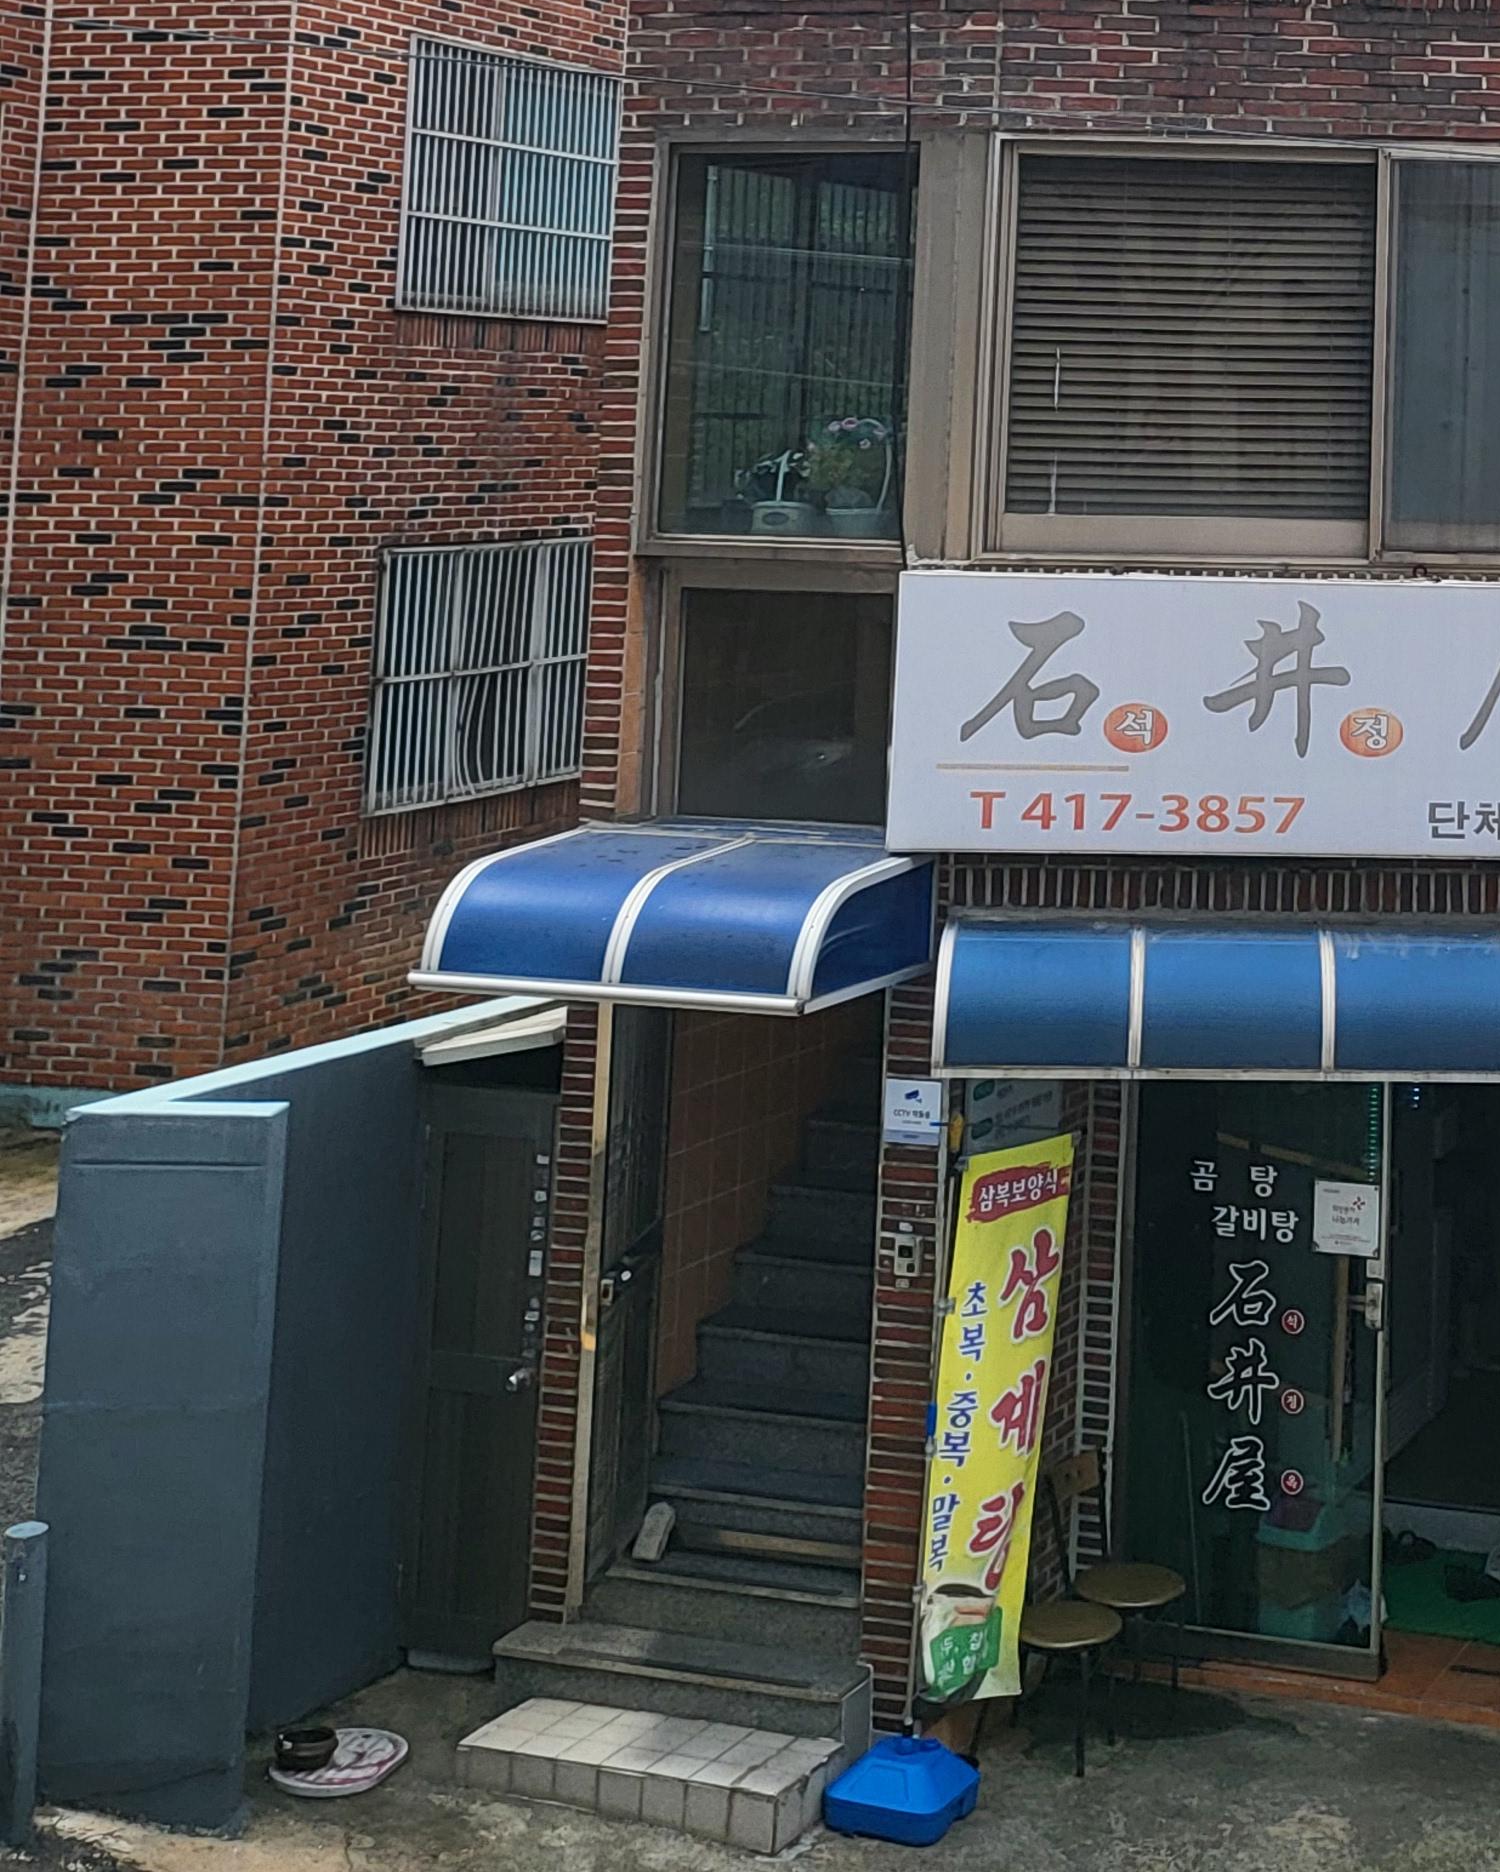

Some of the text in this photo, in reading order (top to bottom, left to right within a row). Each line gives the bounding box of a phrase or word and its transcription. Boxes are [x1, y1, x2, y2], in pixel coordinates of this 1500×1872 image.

[1115, 709, 1154, 746] 석
[1350, 713, 1389, 752] 정
[970, 790, 1307, 835] T 417-3857
[978, 1167, 1059, 1213] 삼복보양식
[1211, 1205, 1300, 1244] 갈비탕
